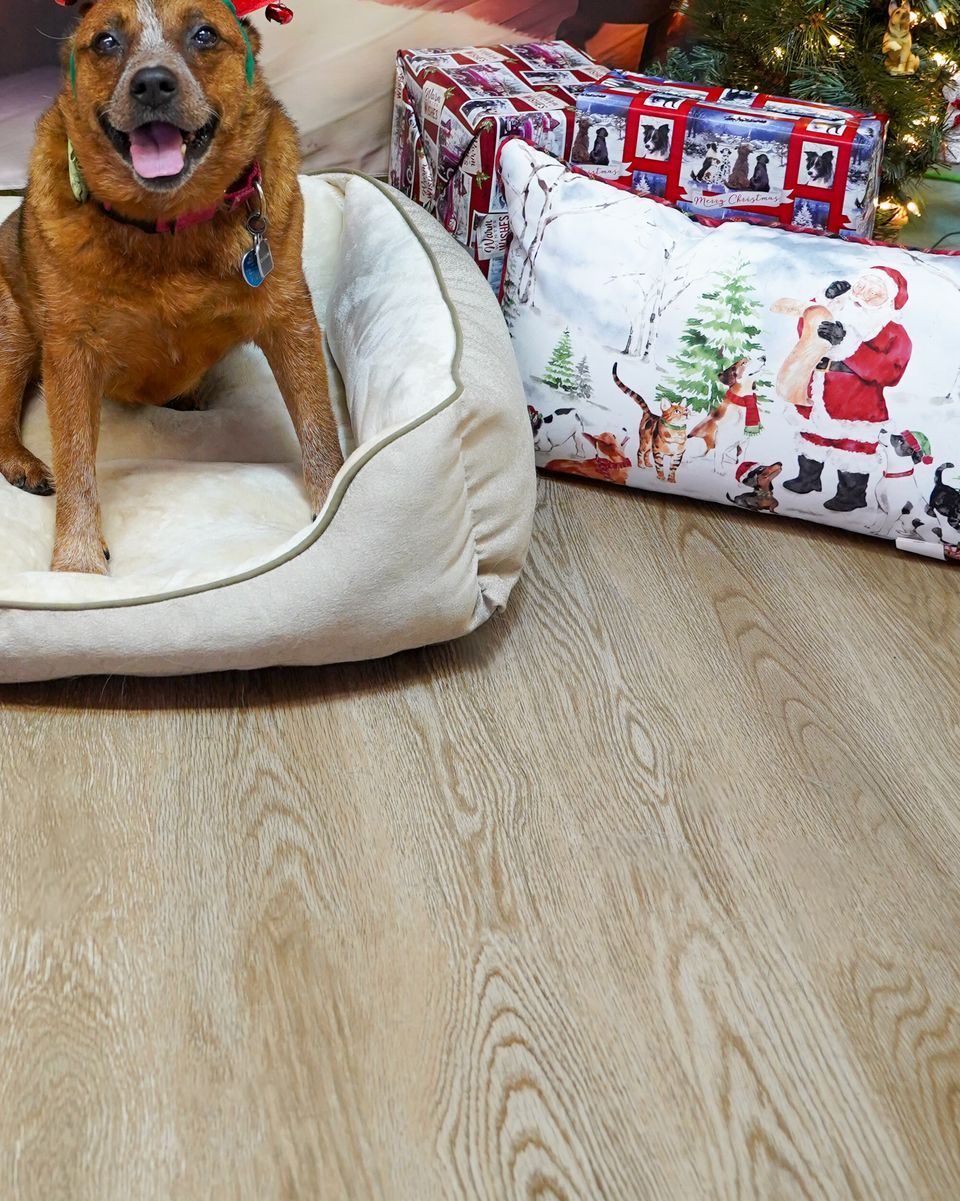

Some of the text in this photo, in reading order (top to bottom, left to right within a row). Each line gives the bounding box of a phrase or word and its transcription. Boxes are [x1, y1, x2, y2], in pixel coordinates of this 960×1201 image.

[694, 193, 779, 207] Merry Christmas
[481, 219, 495, 253] Warm
